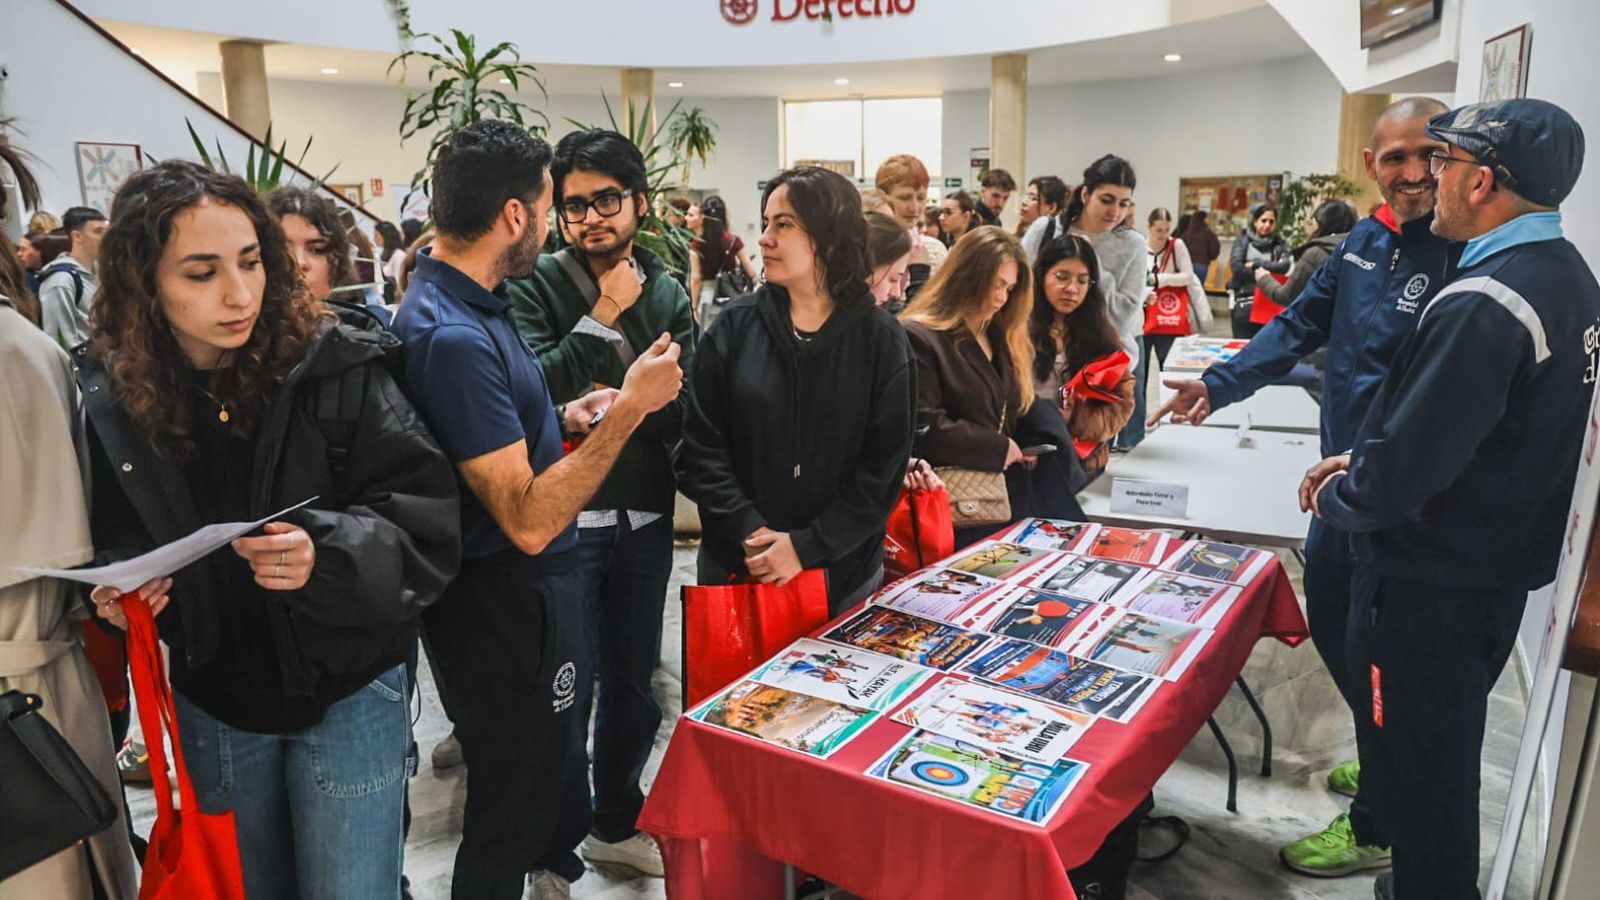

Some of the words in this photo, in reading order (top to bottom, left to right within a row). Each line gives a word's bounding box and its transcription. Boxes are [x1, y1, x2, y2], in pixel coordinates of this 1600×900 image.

[771, 0, 916, 22] Derecho
[859, 677, 889, 698] KAYAK
[1090, 680, 1124, 702] TORNEO
[1036, 720, 1067, 739] MILLA
[1024, 737, 1050, 753] UHU
